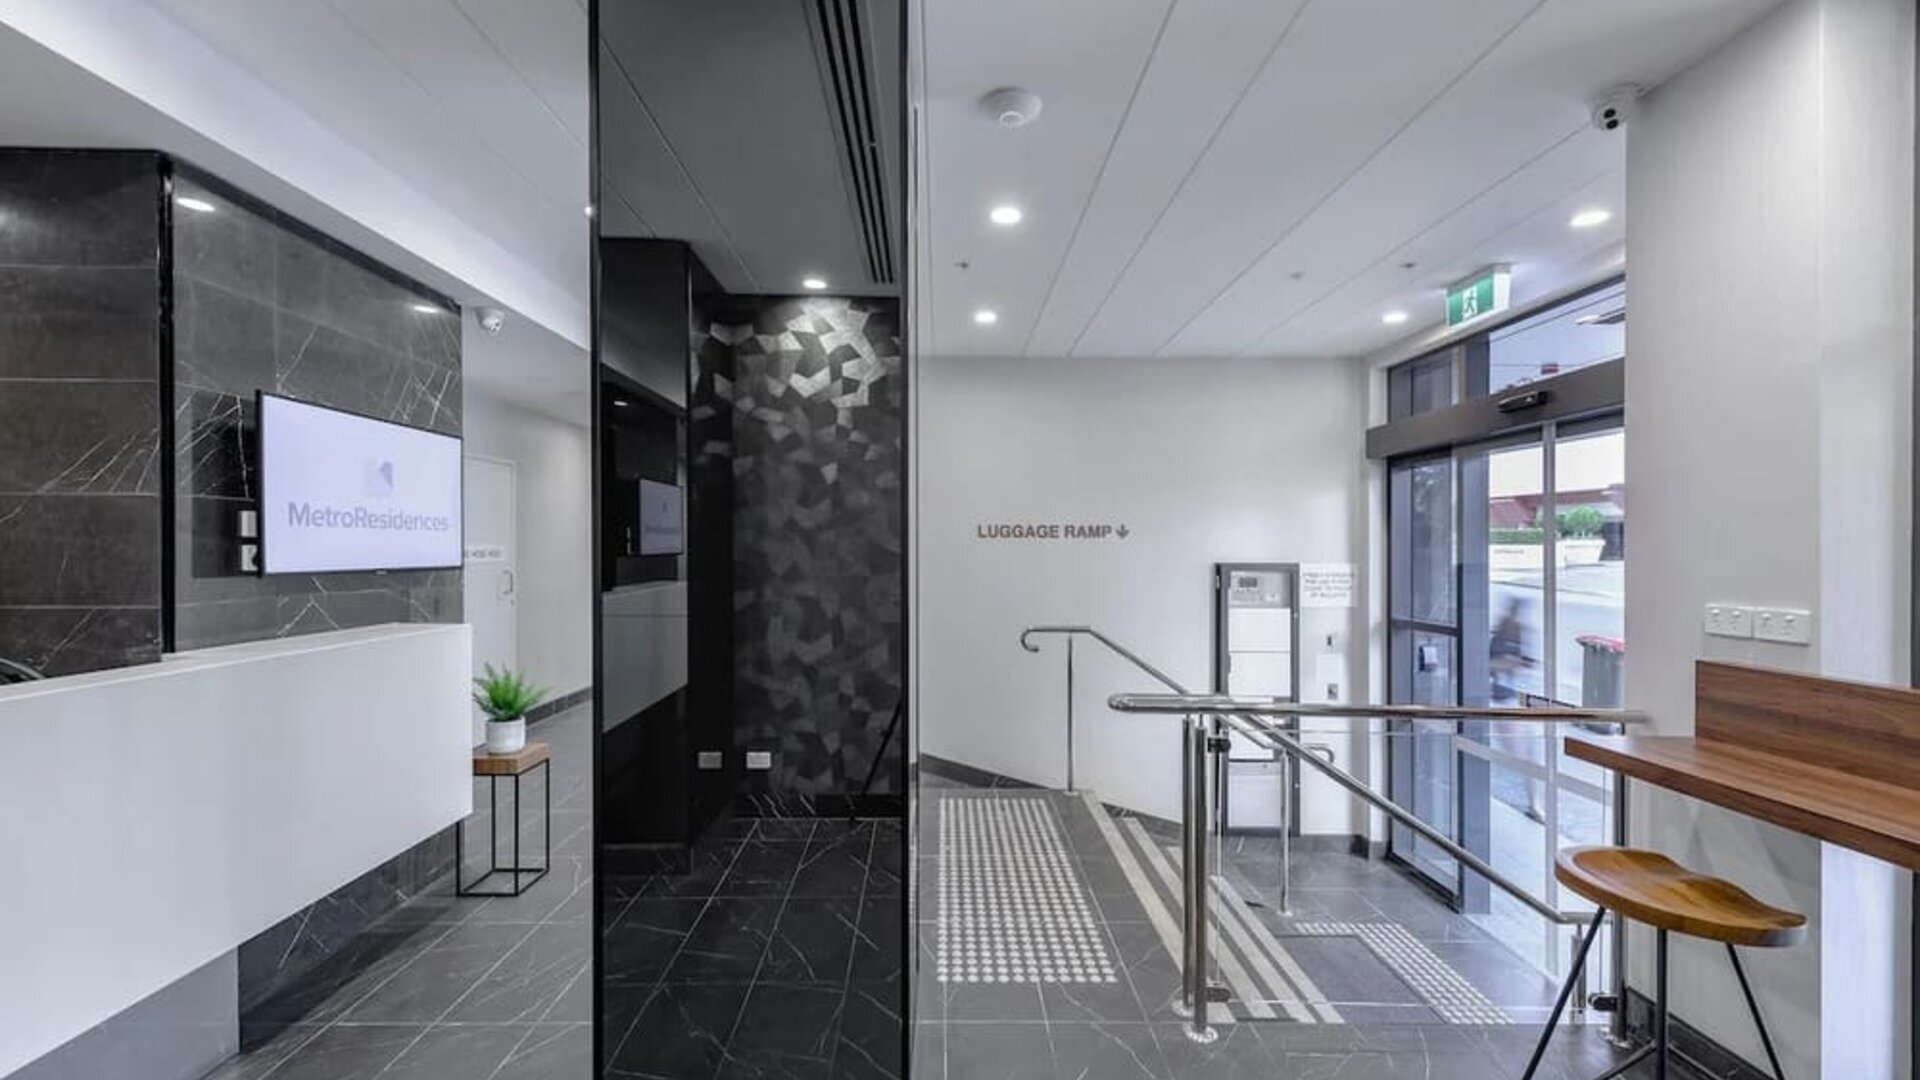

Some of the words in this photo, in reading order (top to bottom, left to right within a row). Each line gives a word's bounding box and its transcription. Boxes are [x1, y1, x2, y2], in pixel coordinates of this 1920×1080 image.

[288, 502, 448, 530] MetroResidences
[977, 524, 1059, 538] LUGGAGE
[1065, 524, 1112, 538] RAMP
